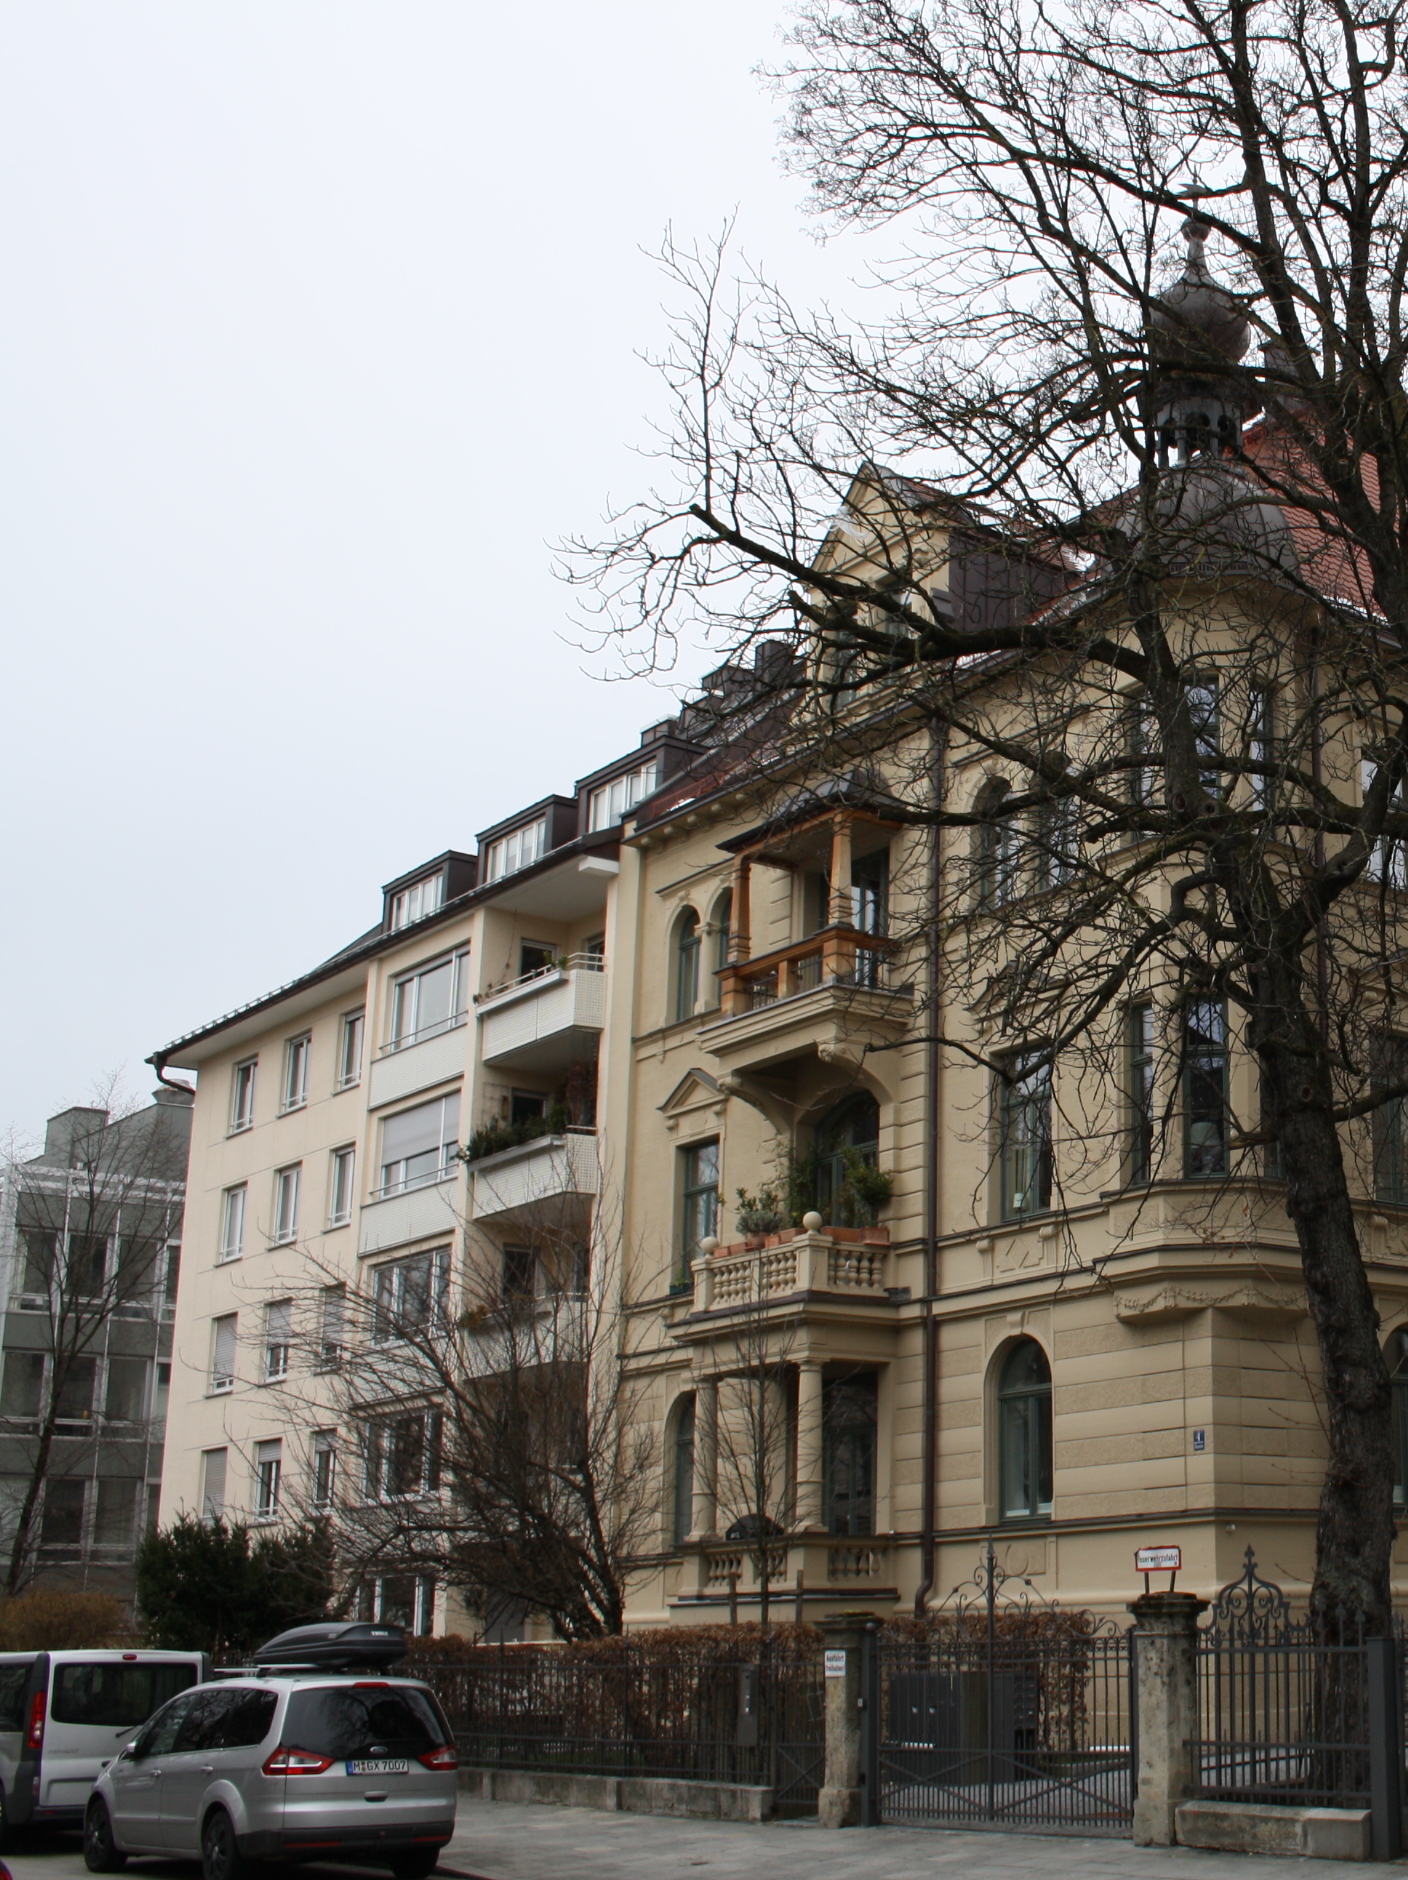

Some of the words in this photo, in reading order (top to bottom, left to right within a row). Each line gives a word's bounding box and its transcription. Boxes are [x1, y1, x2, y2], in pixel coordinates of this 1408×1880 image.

[353, 1761, 361, 1771] M
[367, 1761, 380, 1770] GX
[382, 1759, 406, 1770] 7007
